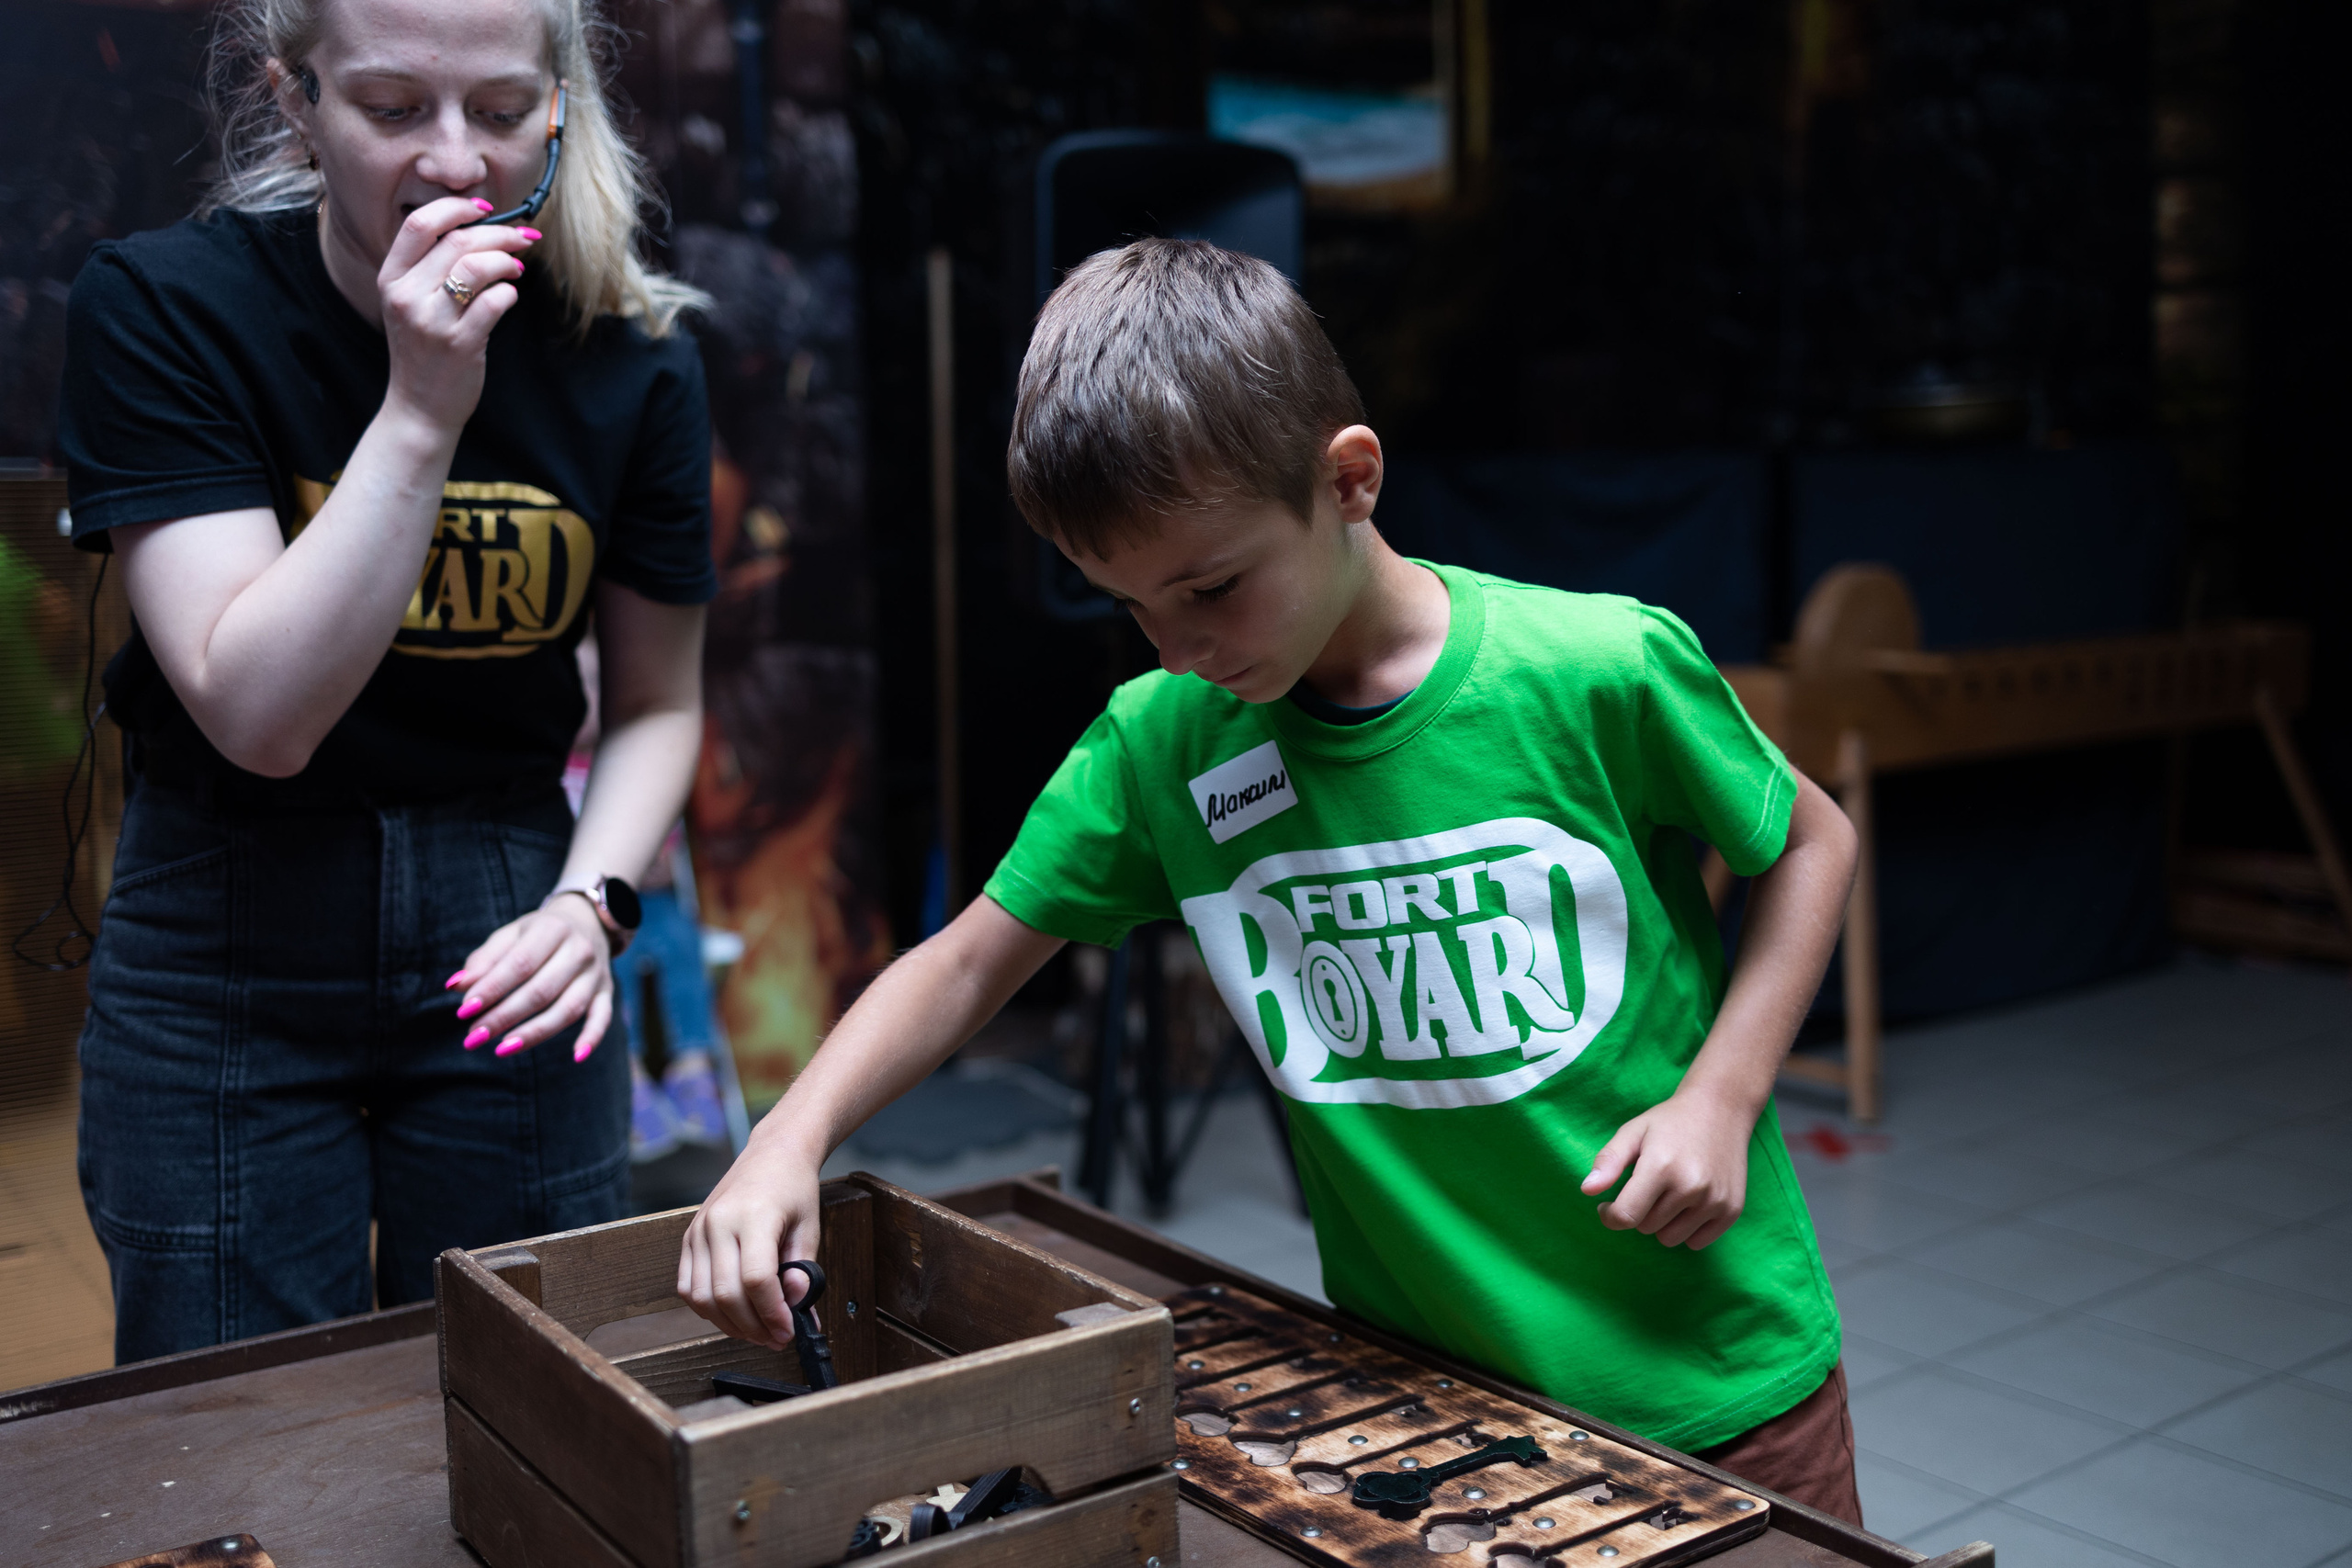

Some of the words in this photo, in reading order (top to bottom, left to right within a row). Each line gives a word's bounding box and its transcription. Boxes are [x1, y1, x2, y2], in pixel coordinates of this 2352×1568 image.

[433, 507, 506, 543] RT
[1290, 860, 1488, 933] FORT
[1181, 819, 1628, 1109] BOYARD
